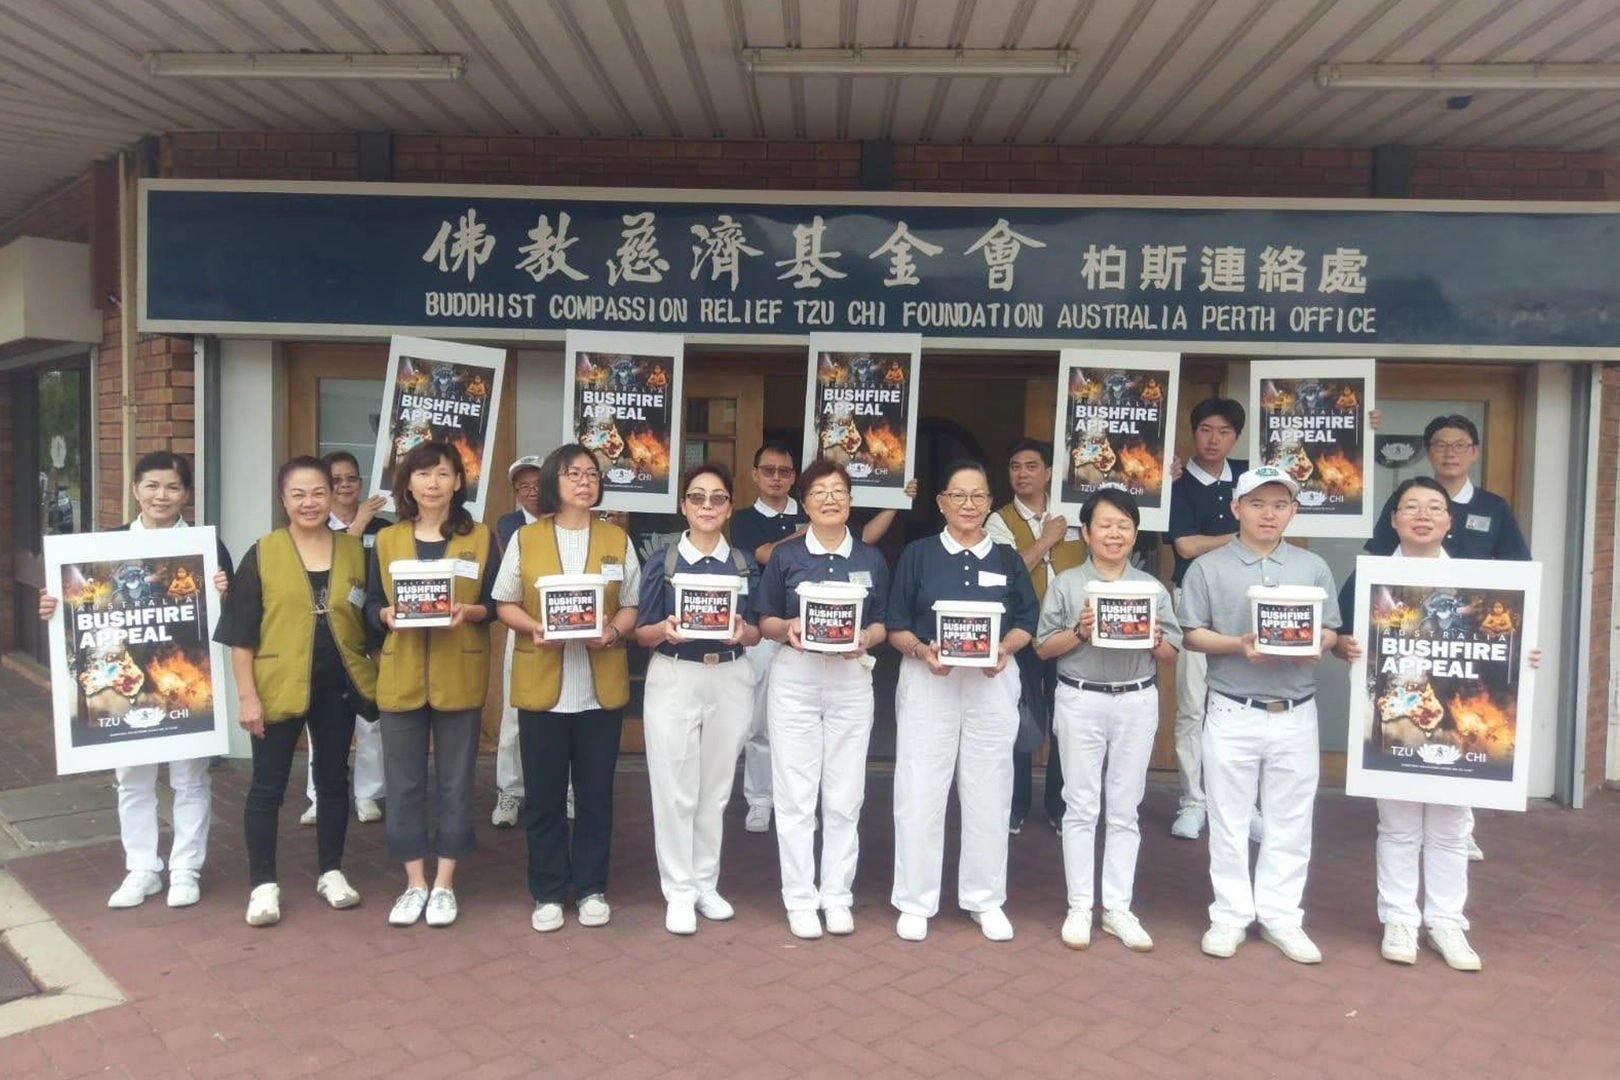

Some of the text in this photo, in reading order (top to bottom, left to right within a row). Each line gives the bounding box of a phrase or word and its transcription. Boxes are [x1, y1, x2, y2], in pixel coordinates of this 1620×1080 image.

[1081, 243, 1368, 294] 柏斯連絡處
[425, 292, 1377, 333] BUDDHIST COMPASSION RELIEF TZU CHI FOUNDATION AUSTRALIA PERTH OFFICE
[583, 391, 664, 407] BUSHFIRE
[824, 388, 901, 402] BUSHFIRE
[401, 394, 481, 416] BUSHFIRE
[823, 403, 883, 415] APPEAL
[400, 409, 462, 428] APPEAL
[583, 405, 646, 421] APPEAL
[1075, 405, 1158, 421] BUSHFIRE
[1075, 419, 1139, 434] APPEAL
[1269, 416, 1355, 429] BUSHFIRE
[1269, 430, 1336, 442] APPEAL
[638, 473, 652, 481] CHI
[1081, 484, 1144, 495] TZU CHI
[1329, 495, 1344, 503] CHI
[397, 584, 447, 593] BUSHFIRE
[398, 593, 437, 602] APPEAL
[548, 596, 593, 605] BUSHFIRE
[684, 595, 728, 605] BUSHFIRE
[78, 596, 193, 612] AUSTRALIA
[549, 605, 584, 613] APPEAL
[684, 605, 719, 613] APPEAL
[1100, 604, 1147, 613] BUSHFIRE
[77, 605, 195, 630] BUSHFIRE
[809, 608, 852, 618] BUSHFIRE
[1101, 613, 1139, 622] APPEAL
[1260, 610, 1310, 620] BUSHFIRE
[809, 617, 844, 626] APPEAL
[943, 623, 987, 632] BUSHFIRE
[1261, 619, 1300, 628] APPEAL
[80, 625, 172, 649] APPEAL
[943, 631, 978, 640] APPEAL
[1383, 629, 1506, 641] AUSTRALIA
[1381, 638, 1507, 661] BUSHFIRE
[1381, 656, 1479, 679] APPEAL
[98, 709, 189, 728] TZU CHI
[1391, 746, 1486, 762] TZU CHI
